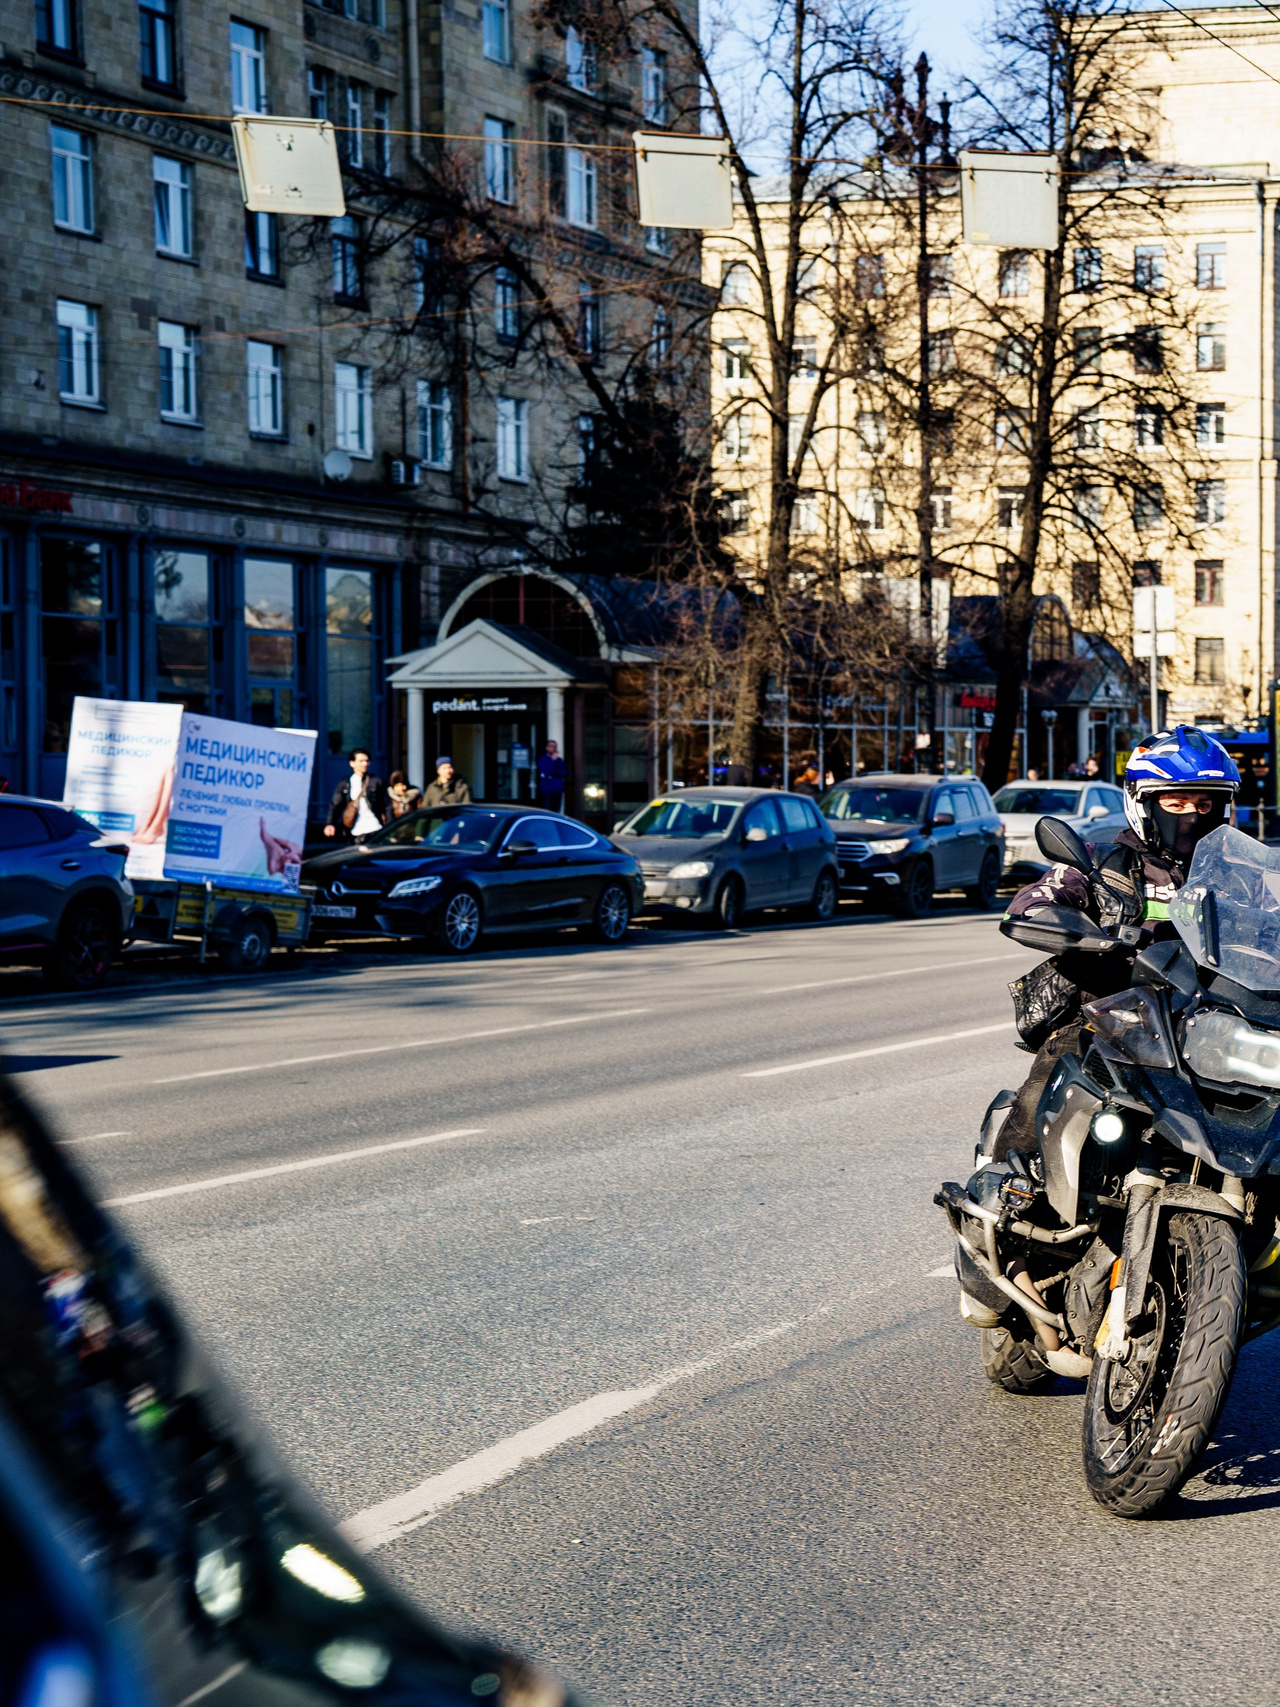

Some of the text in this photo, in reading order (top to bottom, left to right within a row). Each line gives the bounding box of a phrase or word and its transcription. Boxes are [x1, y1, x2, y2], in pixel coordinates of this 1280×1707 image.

[20, 480, 74, 512] Банк
[78, 730, 172, 746] МЕДИЦИНСКИЙ
[91, 744, 151, 758] ПЕДИКЮР
[185, 737, 307, 773] МЕДИЦИНСКИЙ
[182, 762, 265, 790] ПЕДИКЮР
[180, 789, 291, 812] ЛЕЧЕНИЕ ЛЮБЫХ ПРОБЛЕМ
[186, 803, 227, 816] НОГТЯМИ
